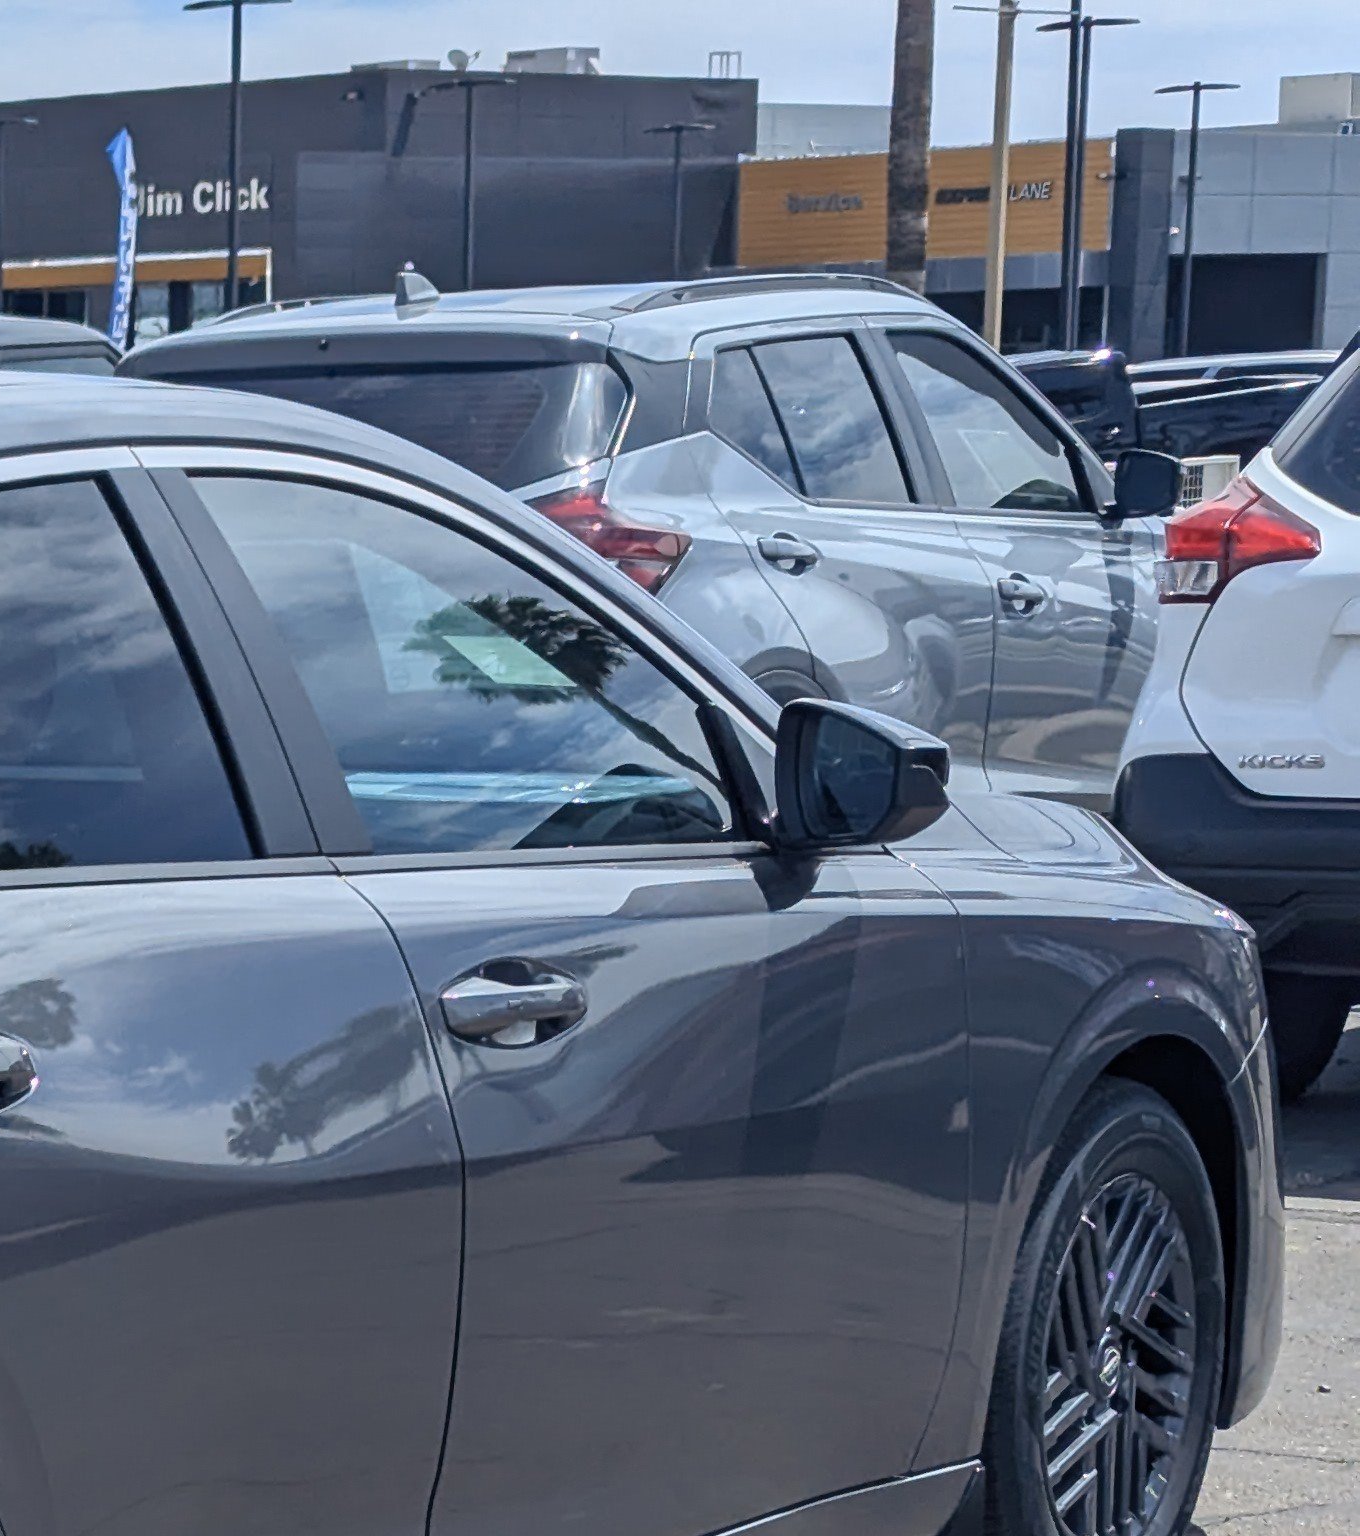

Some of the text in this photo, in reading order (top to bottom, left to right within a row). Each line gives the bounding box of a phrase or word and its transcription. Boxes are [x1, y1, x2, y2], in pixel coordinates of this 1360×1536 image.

[192, 178, 270, 214] Click
[1008, 181, 1051, 202] LANE
[1238, 753, 1326, 769] KICKS
